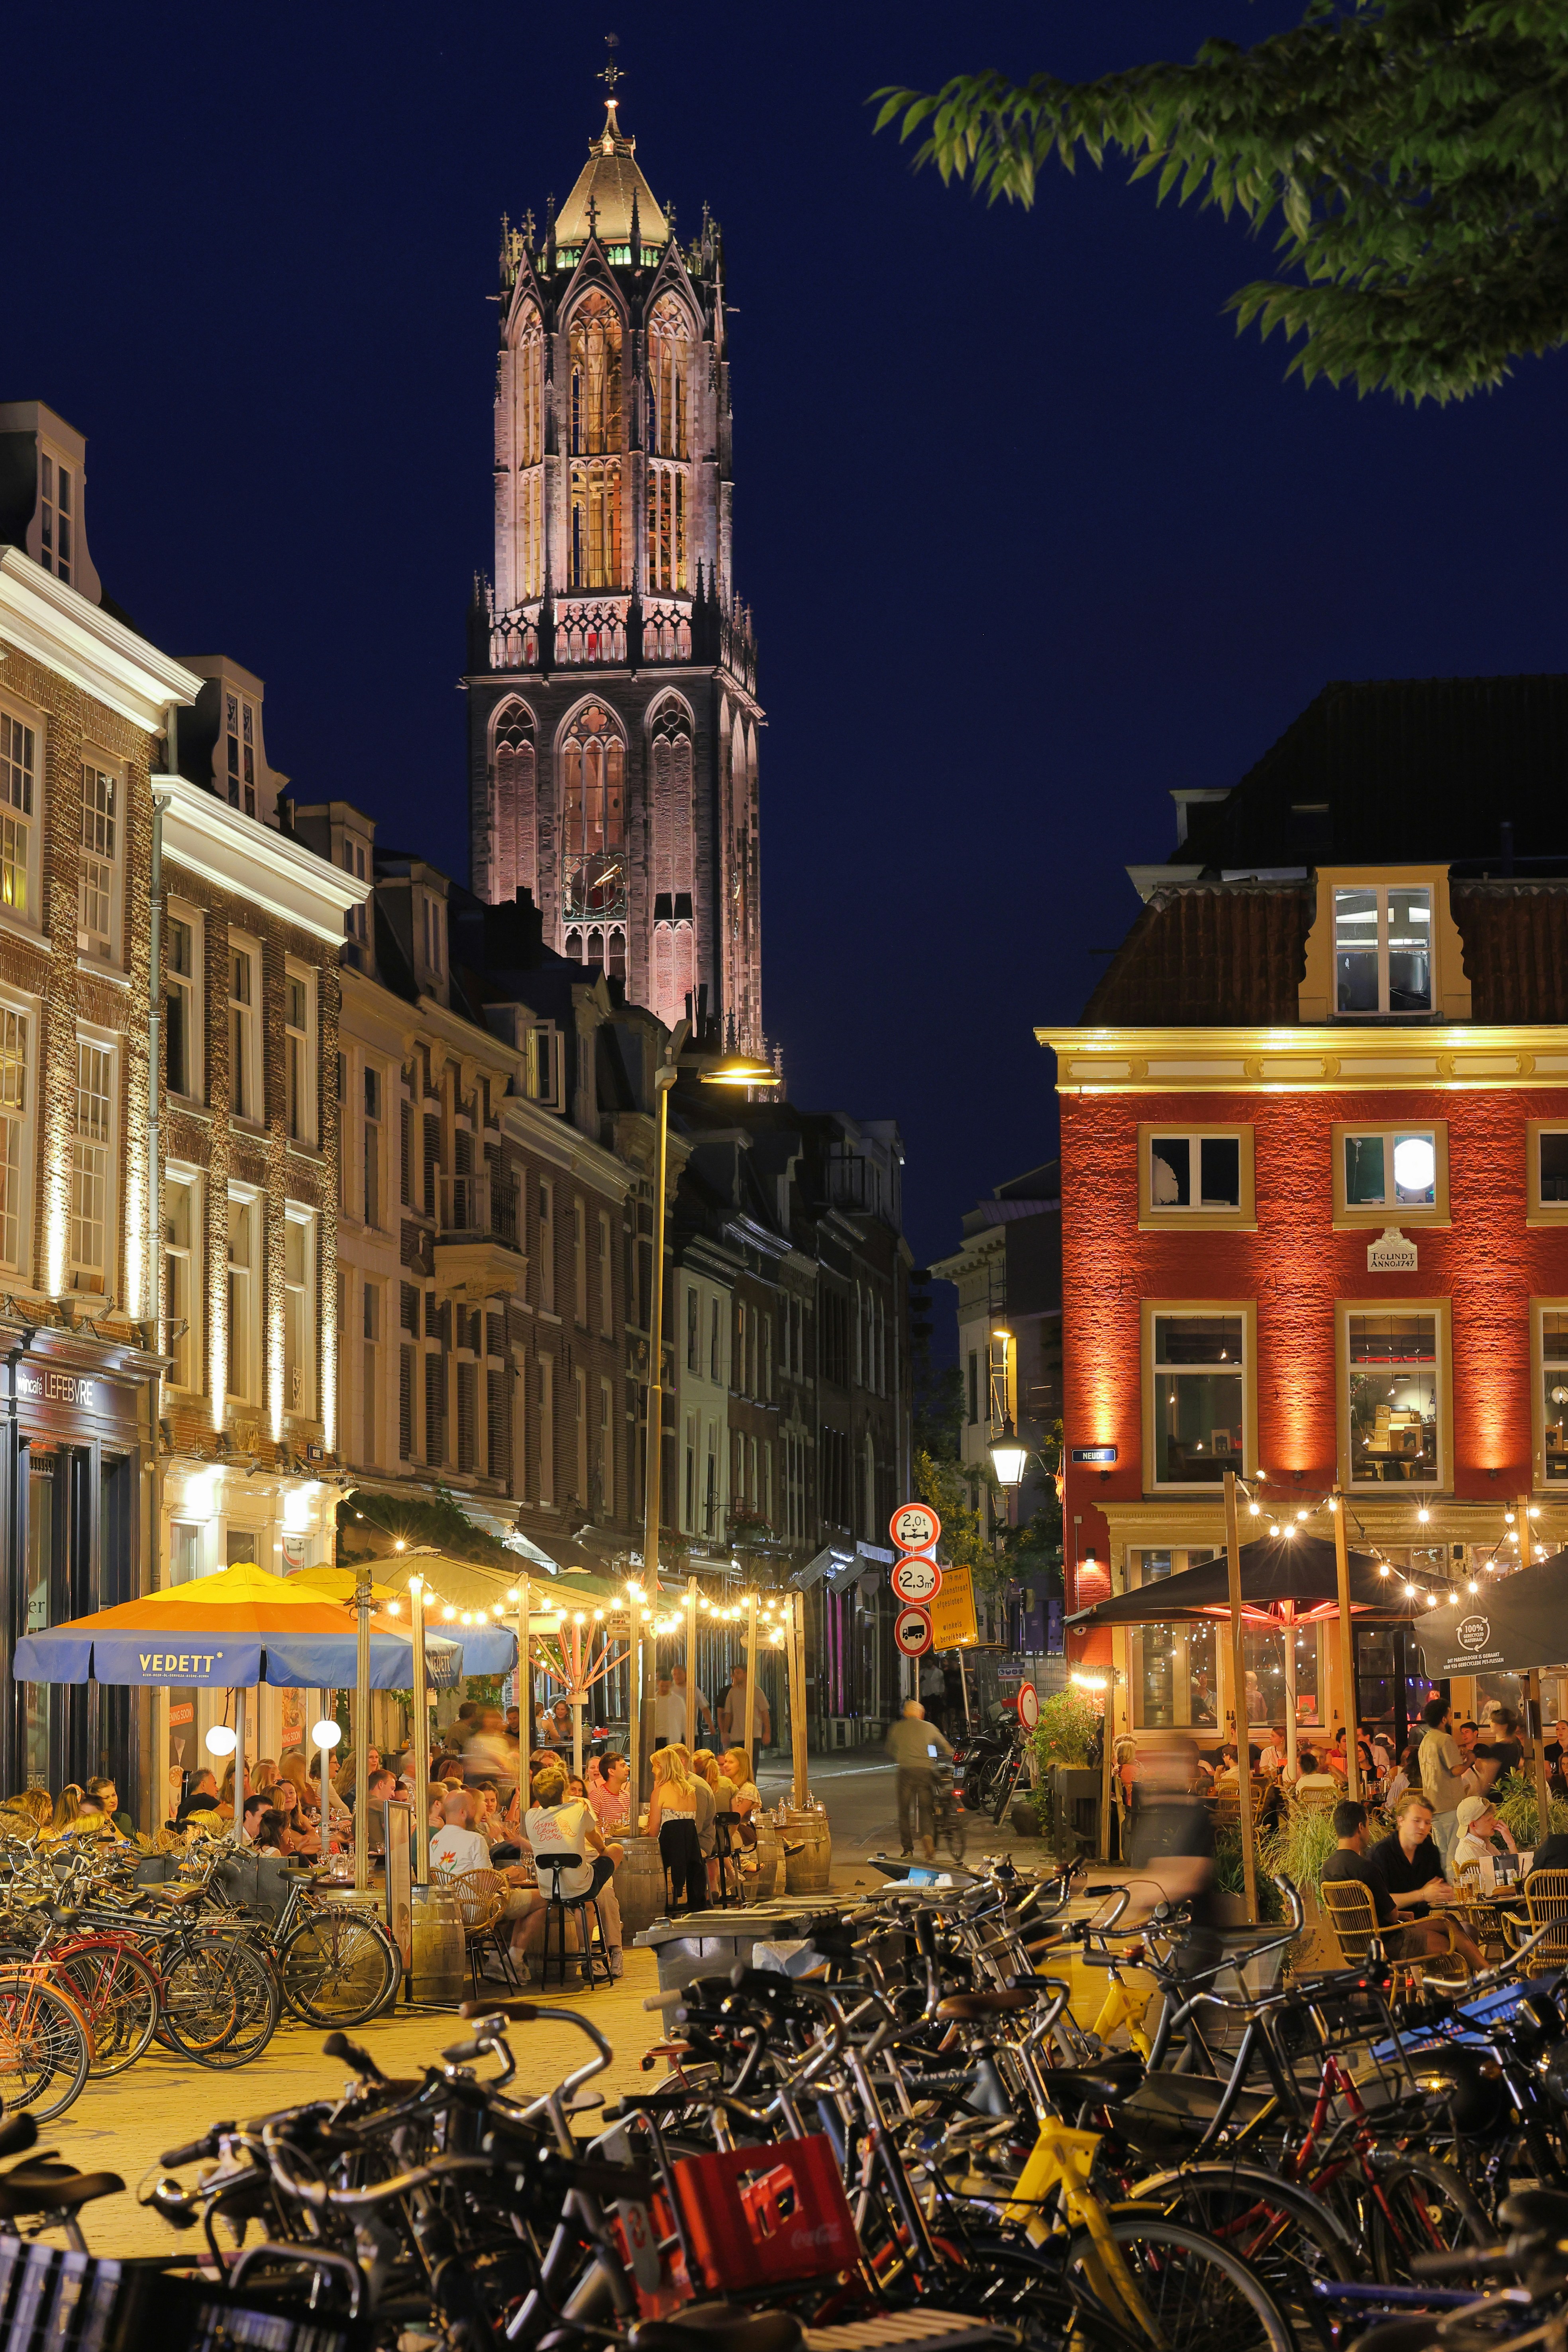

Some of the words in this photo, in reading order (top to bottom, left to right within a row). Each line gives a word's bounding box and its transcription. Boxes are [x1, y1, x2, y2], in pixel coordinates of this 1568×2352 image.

[17, 1373, 43, 1395] wijncafé
[45, 1372, 93, 1407] LEFEBVRE
[937, 1597, 963, 1610] afgesloten
[943, 1620, 962, 1631] winkels
[1465, 1624, 1484, 1633] 100%
[940, 1632, 967, 1643] bereikbaar
[139, 1654, 214, 1672] VEDETT
[1458, 1659, 1481, 1668] GERECYCLEDE
[181, 1708, 191, 1720] SOON
[290, 1731, 300, 1741] SOON
[533, 1820, 557, 1830] Aimé
[539, 1833, 562, 1842] Dore
